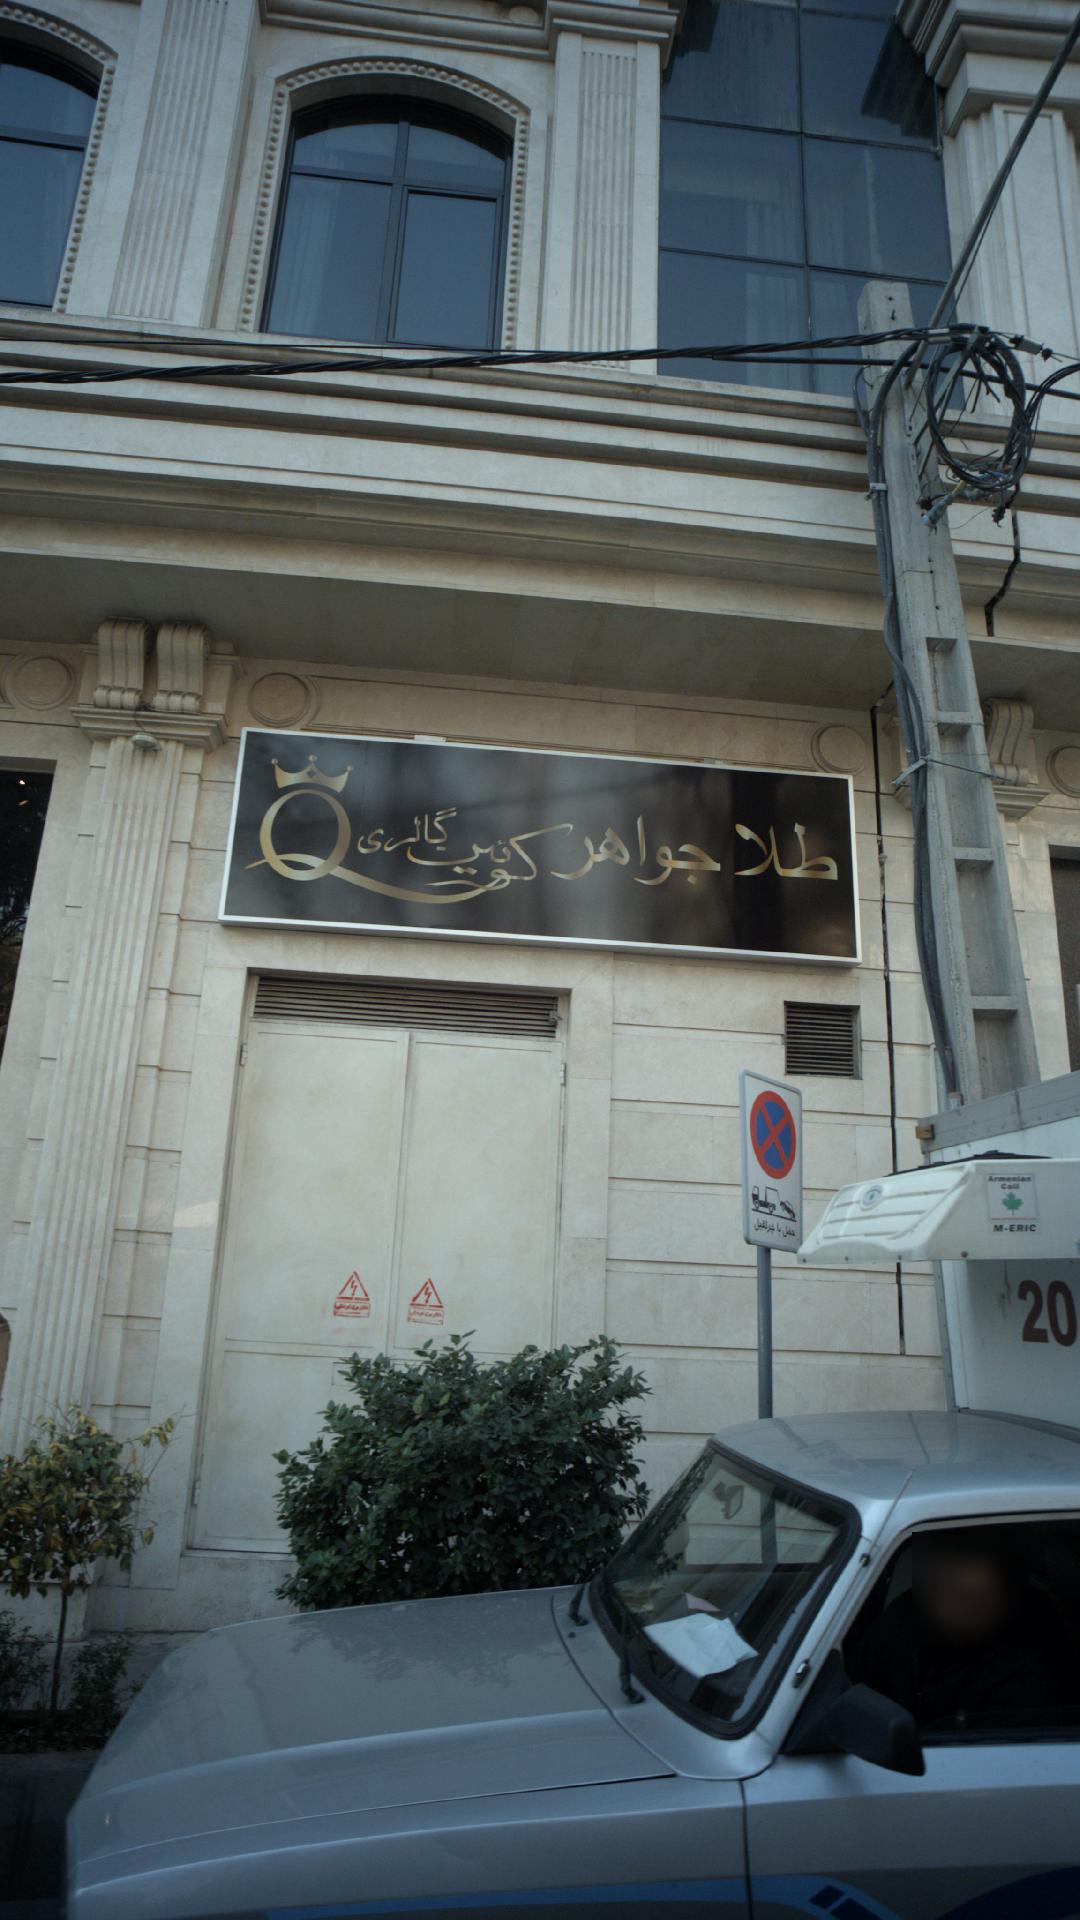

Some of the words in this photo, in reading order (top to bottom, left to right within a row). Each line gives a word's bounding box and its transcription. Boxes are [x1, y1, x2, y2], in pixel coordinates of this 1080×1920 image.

[357, 807, 457, 854] گالری
[551, 816, 720, 885] جواهر
[734, 822, 838, 880] طلا
[992, 1224, 1037, 1232] M-ERIC
[1018, 1279, 1077, 1347] 20
